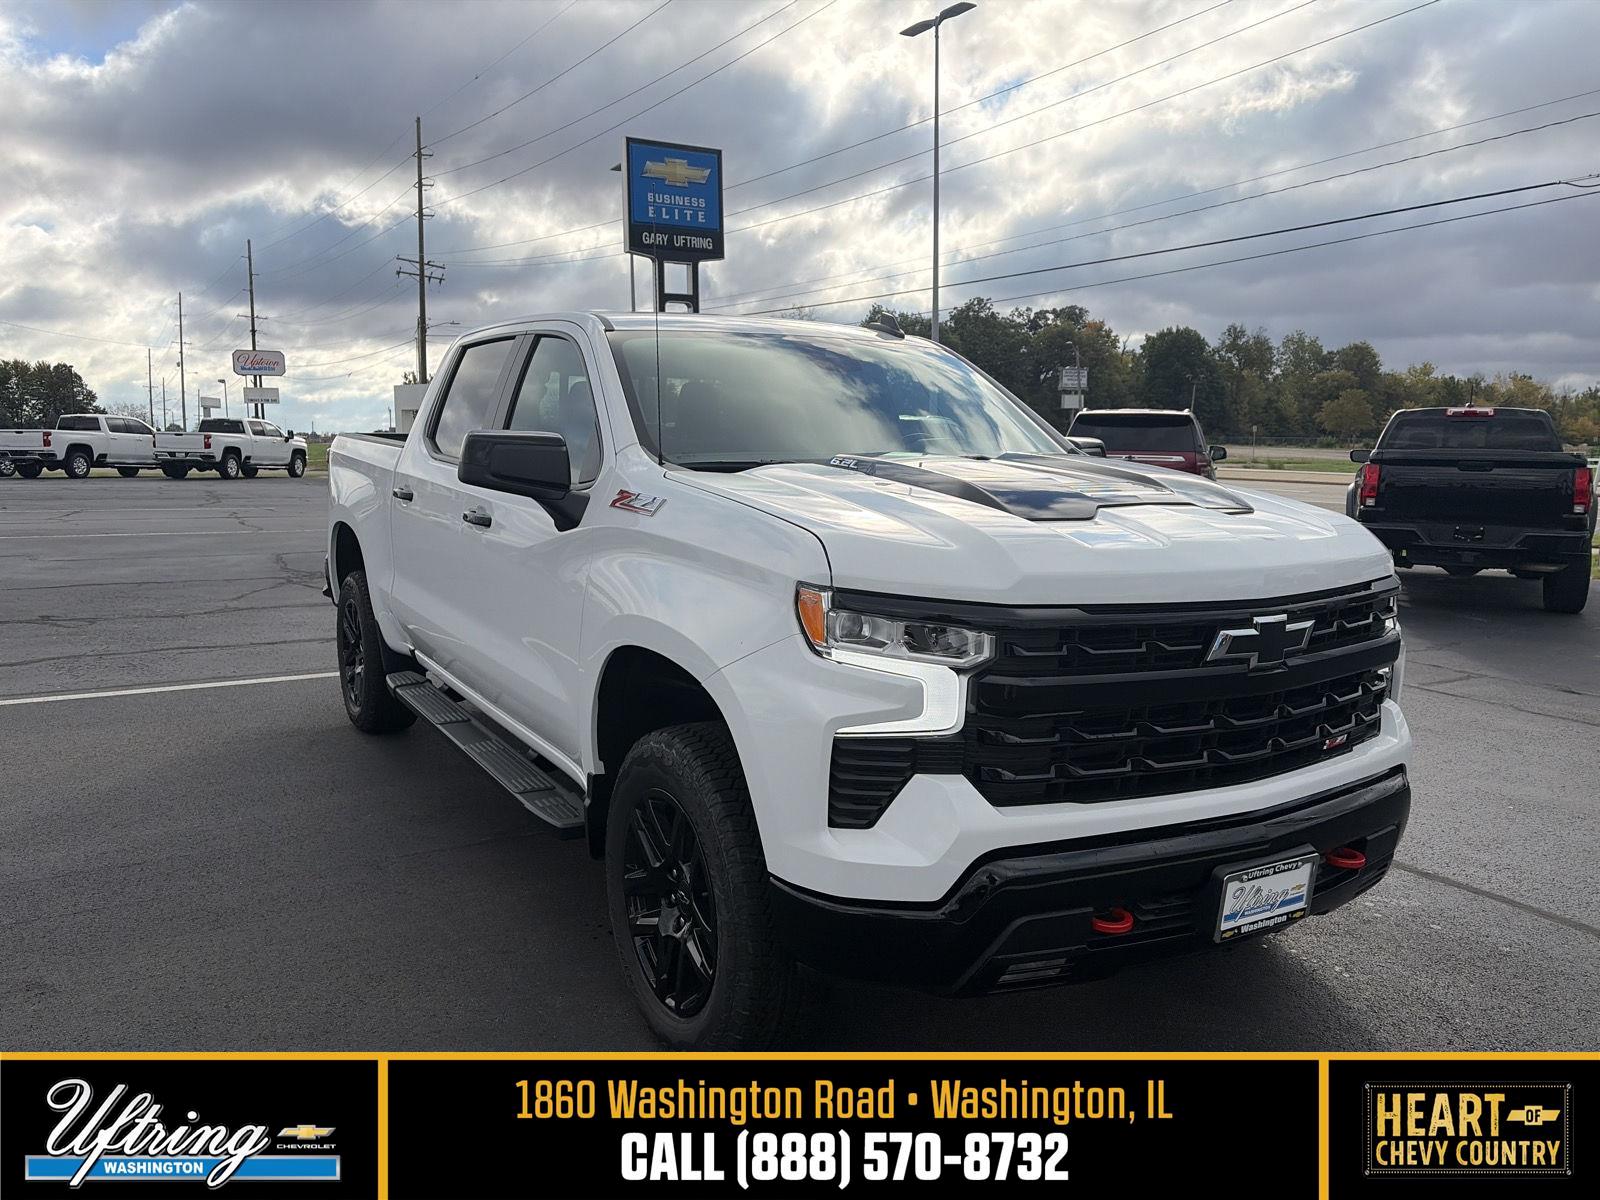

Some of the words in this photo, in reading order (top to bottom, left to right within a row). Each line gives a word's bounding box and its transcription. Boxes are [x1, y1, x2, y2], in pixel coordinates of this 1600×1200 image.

[647, 192, 705, 207] BUSINESS
[648, 206, 705, 222] ELITE
[642, 232, 668, 246] GARY
[674, 235, 712, 249] UFTRING
[609, 489, 667, 517] Z71
[1248, 867, 1274, 879] Uftring
[1275, 861, 1298, 872] Chevy
[1241, 915, 1287, 933] Washington
